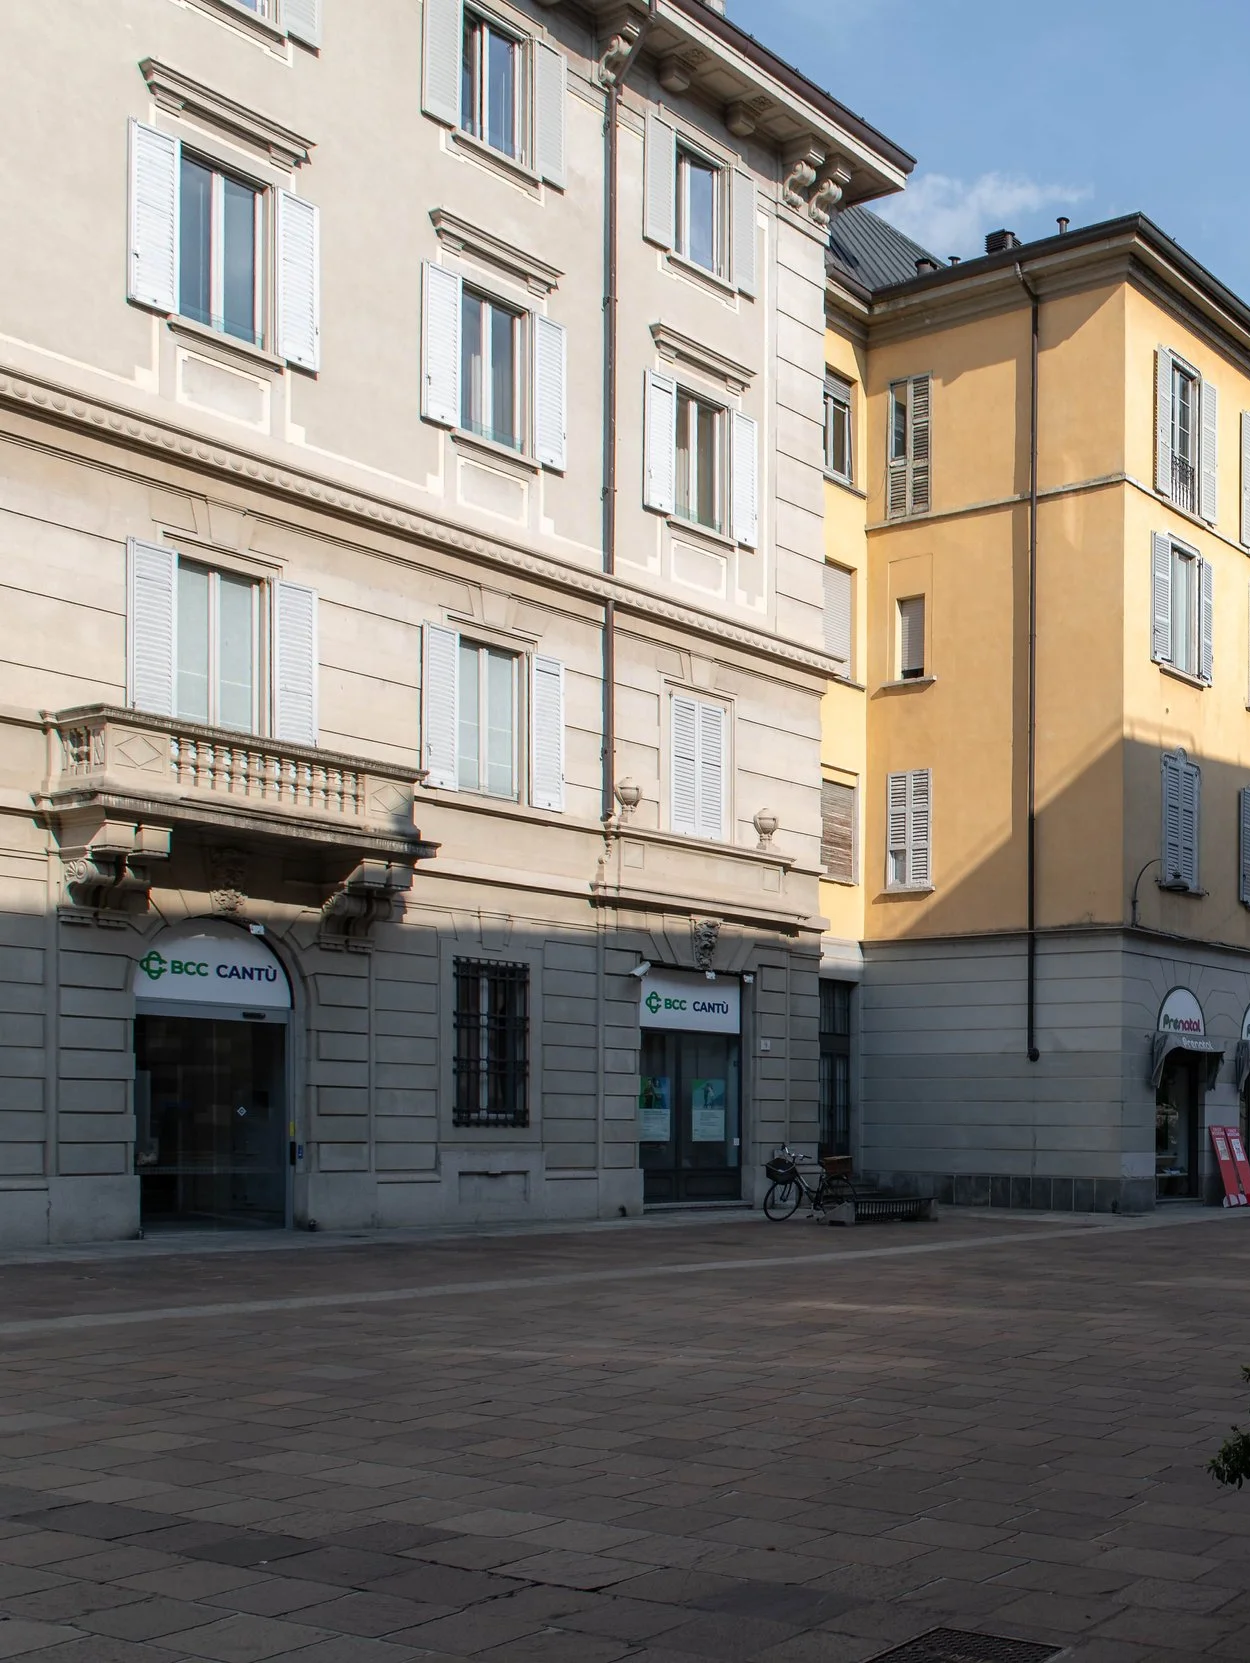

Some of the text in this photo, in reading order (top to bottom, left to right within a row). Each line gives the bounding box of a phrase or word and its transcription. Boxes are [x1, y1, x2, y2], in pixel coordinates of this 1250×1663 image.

[171, 960, 277, 982] BCC CANTÙ
[664, 998, 729, 1014] BCC CANTÙ
[1163, 1014, 1201, 1032] Prenatal
[1182, 1037, 1214, 1050] Prenatal
